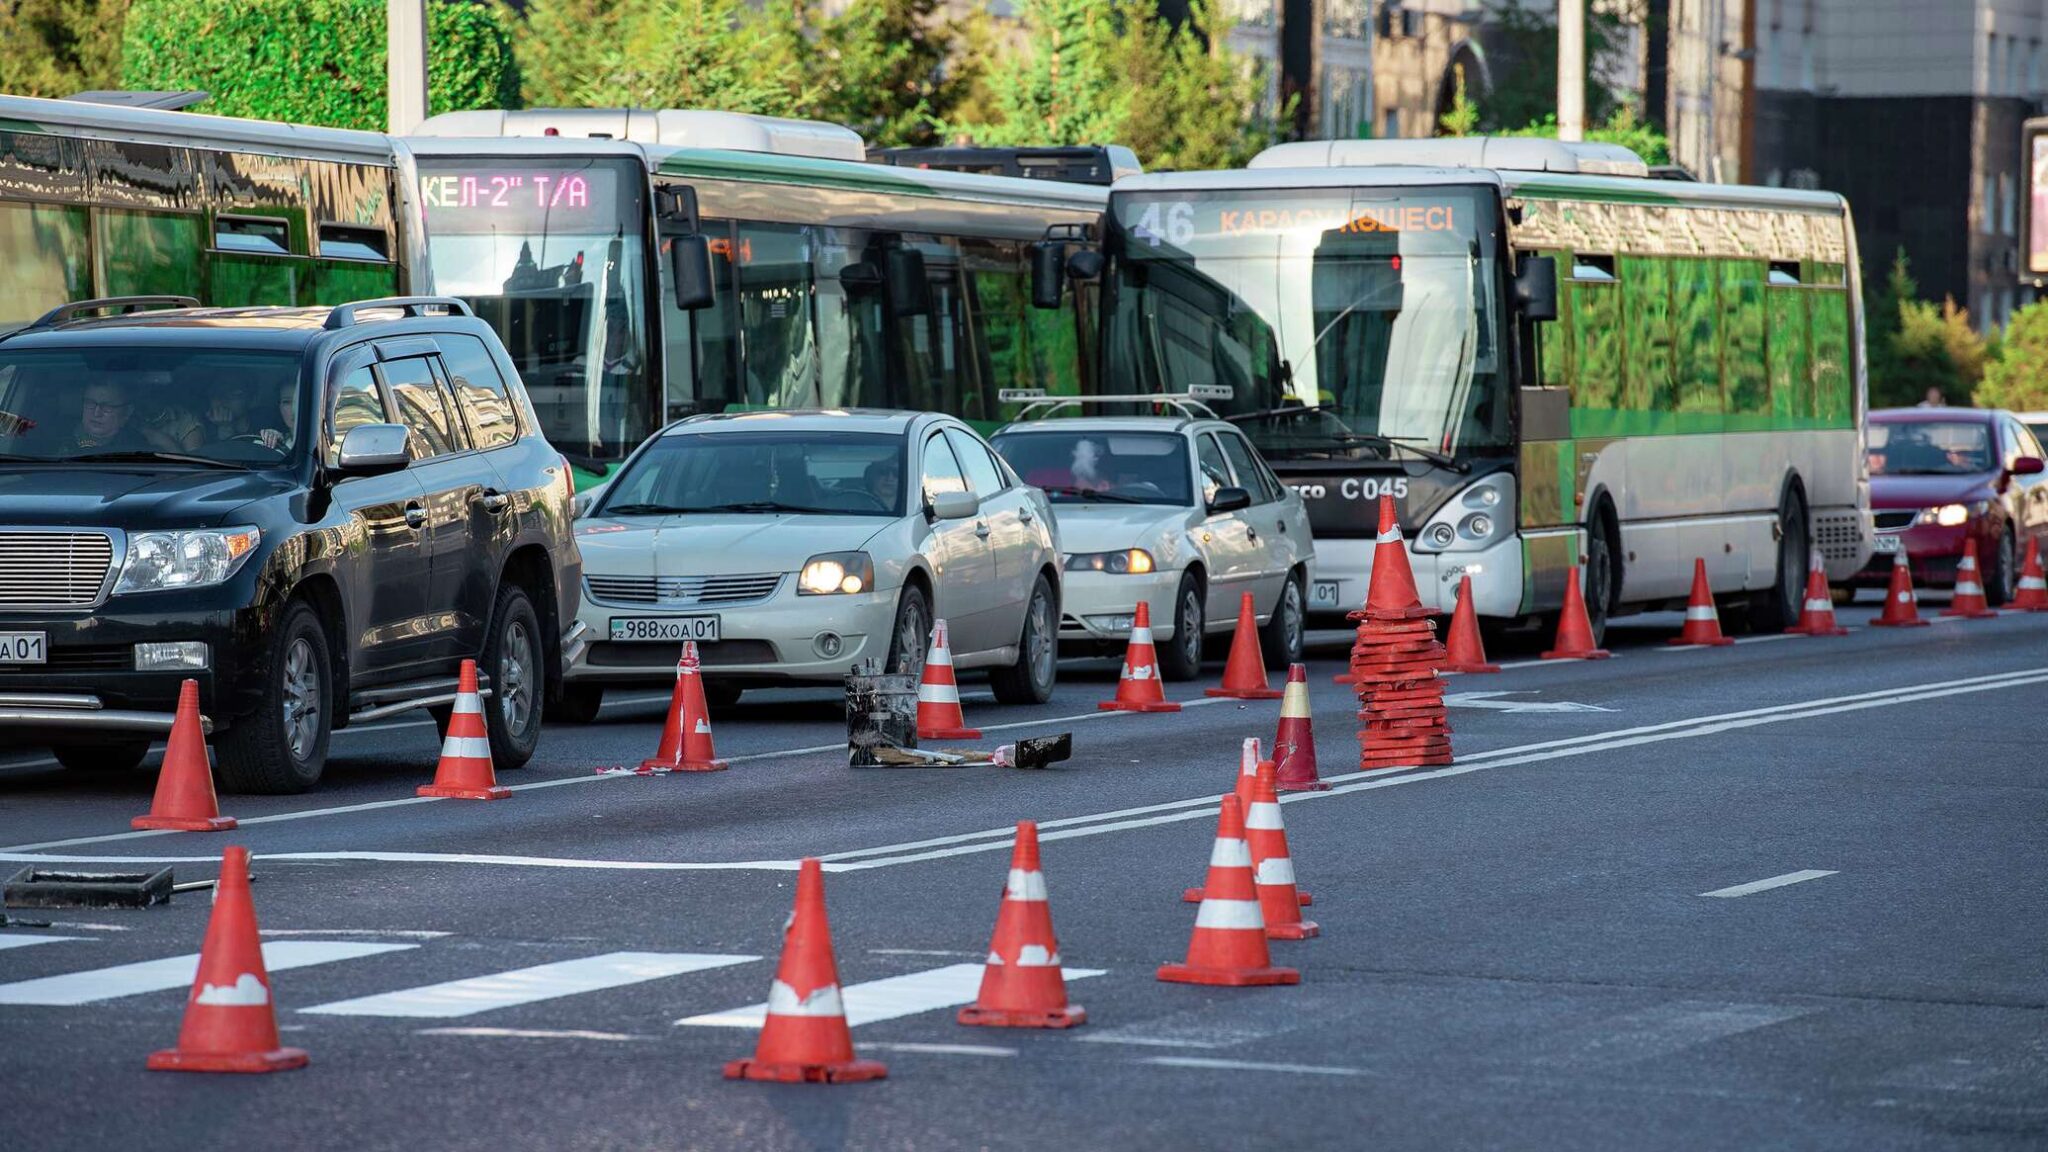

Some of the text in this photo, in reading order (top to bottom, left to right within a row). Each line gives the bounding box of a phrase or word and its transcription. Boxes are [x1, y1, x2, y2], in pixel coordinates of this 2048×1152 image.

[533, 176, 588, 208] Т/А
[1134, 201, 1195, 247] 46
[1318, 585, 1336, 601] 01
[626, 620, 691, 639] 988XOA
[695, 620, 716, 638] 01
[16, 637, 42, 659] 01
